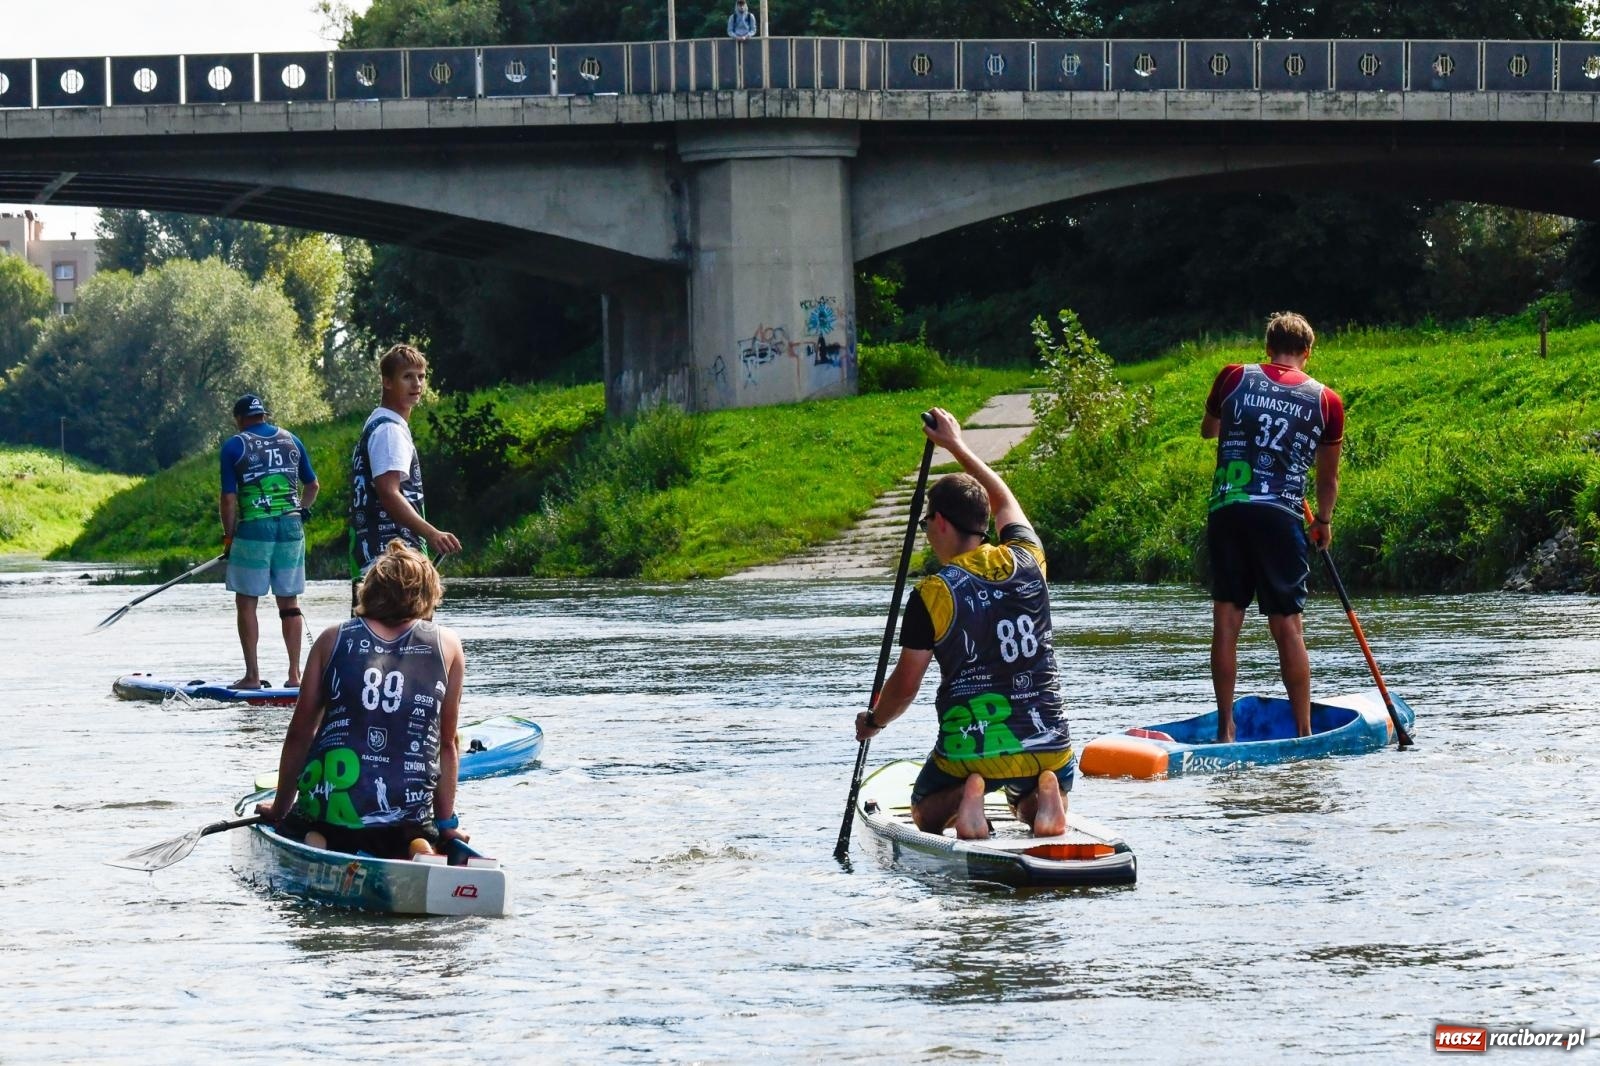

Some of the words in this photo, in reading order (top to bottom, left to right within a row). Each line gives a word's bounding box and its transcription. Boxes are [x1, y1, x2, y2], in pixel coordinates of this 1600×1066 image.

[1243, 392, 1303, 418] KLIMASZYK
[1304, 409, 1312, 422] J
[1255, 413, 1289, 451] 32
[264, 447, 284, 467] 75
[996, 614, 1038, 663] 88
[361, 667, 405, 714] 89
[361, 753, 390, 763] RACIBÓRZ
